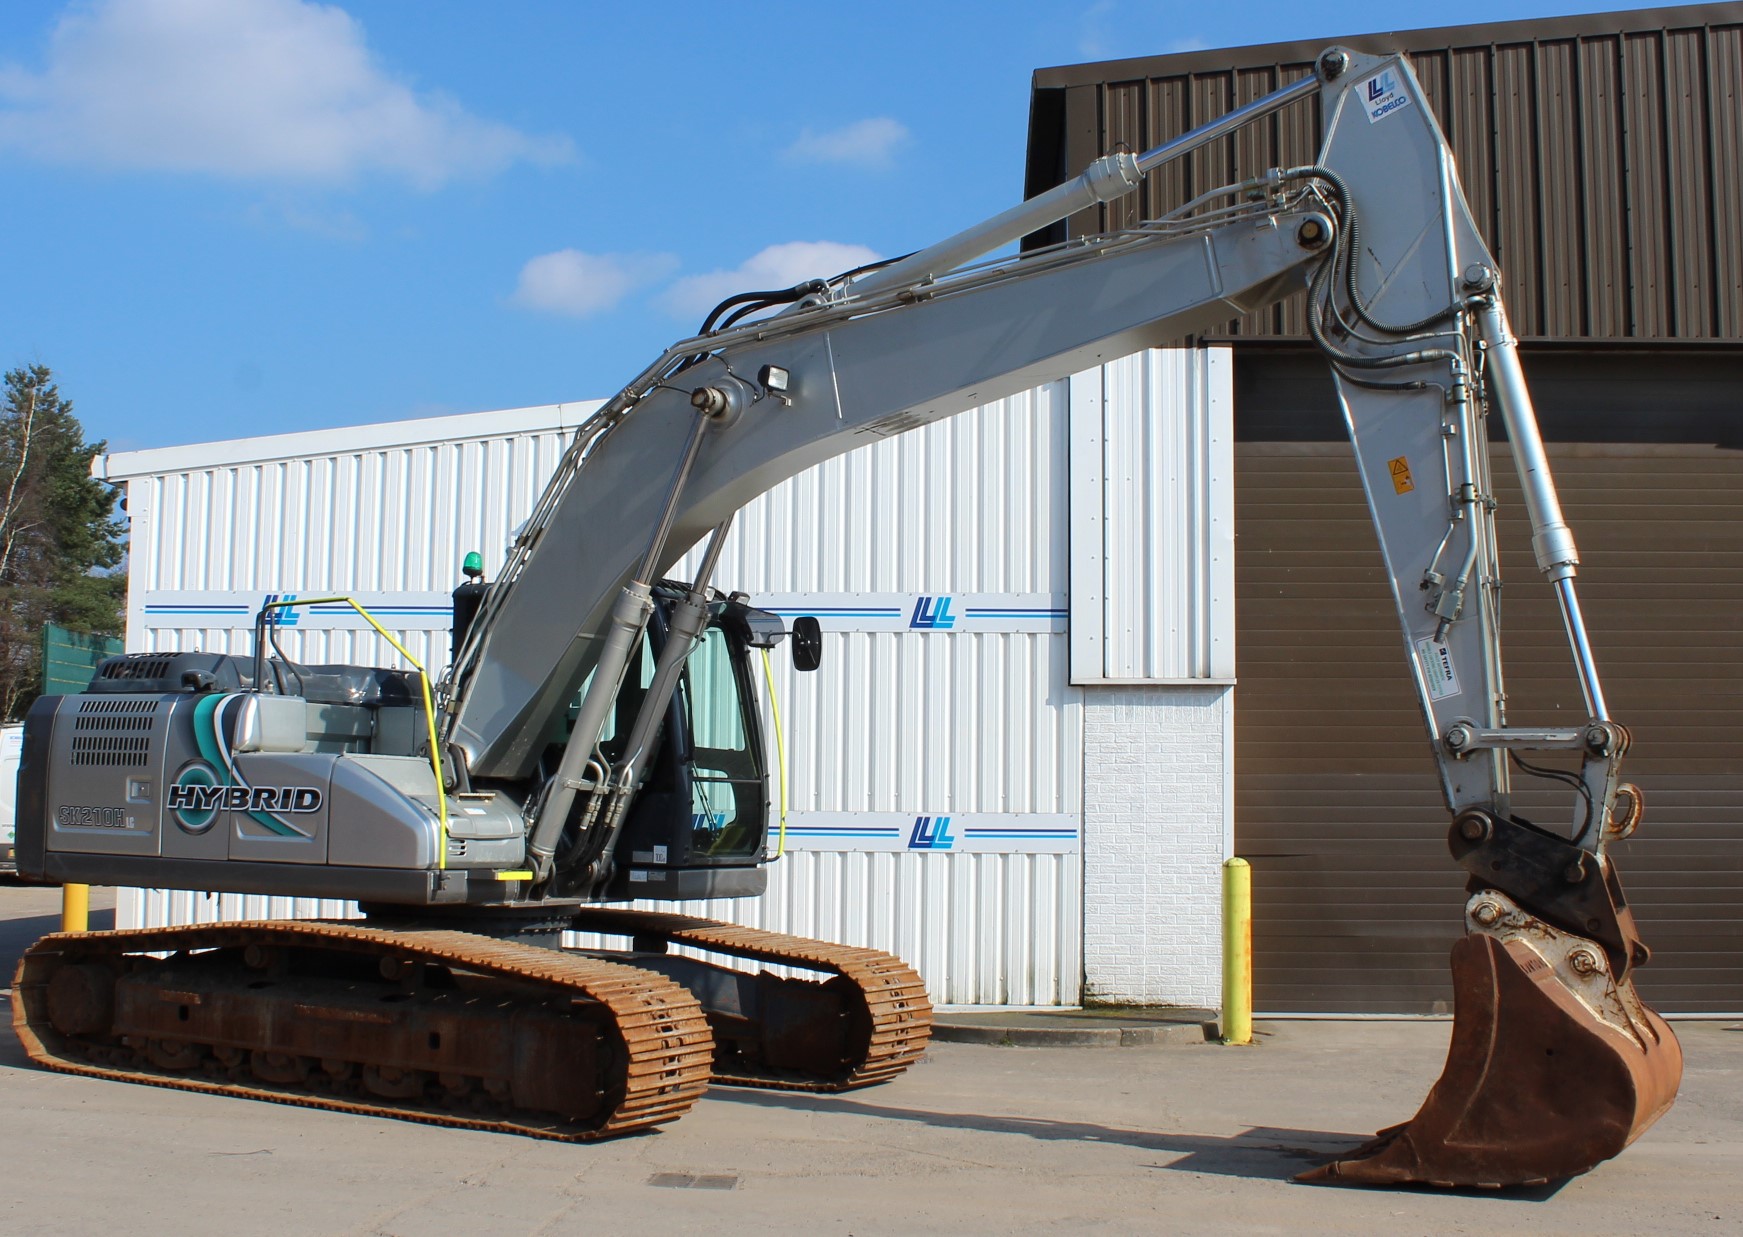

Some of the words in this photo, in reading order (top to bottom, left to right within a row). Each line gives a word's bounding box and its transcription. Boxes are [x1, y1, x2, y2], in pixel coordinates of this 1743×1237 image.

[1371, 95, 1407, 119] KOBELCO
[1375, 92, 1394, 106] Lloyd
[1441, 656, 1453, 681] TEFRA
[167, 784, 323, 813] HYBRID
[59, 805, 126, 827] SK210H
